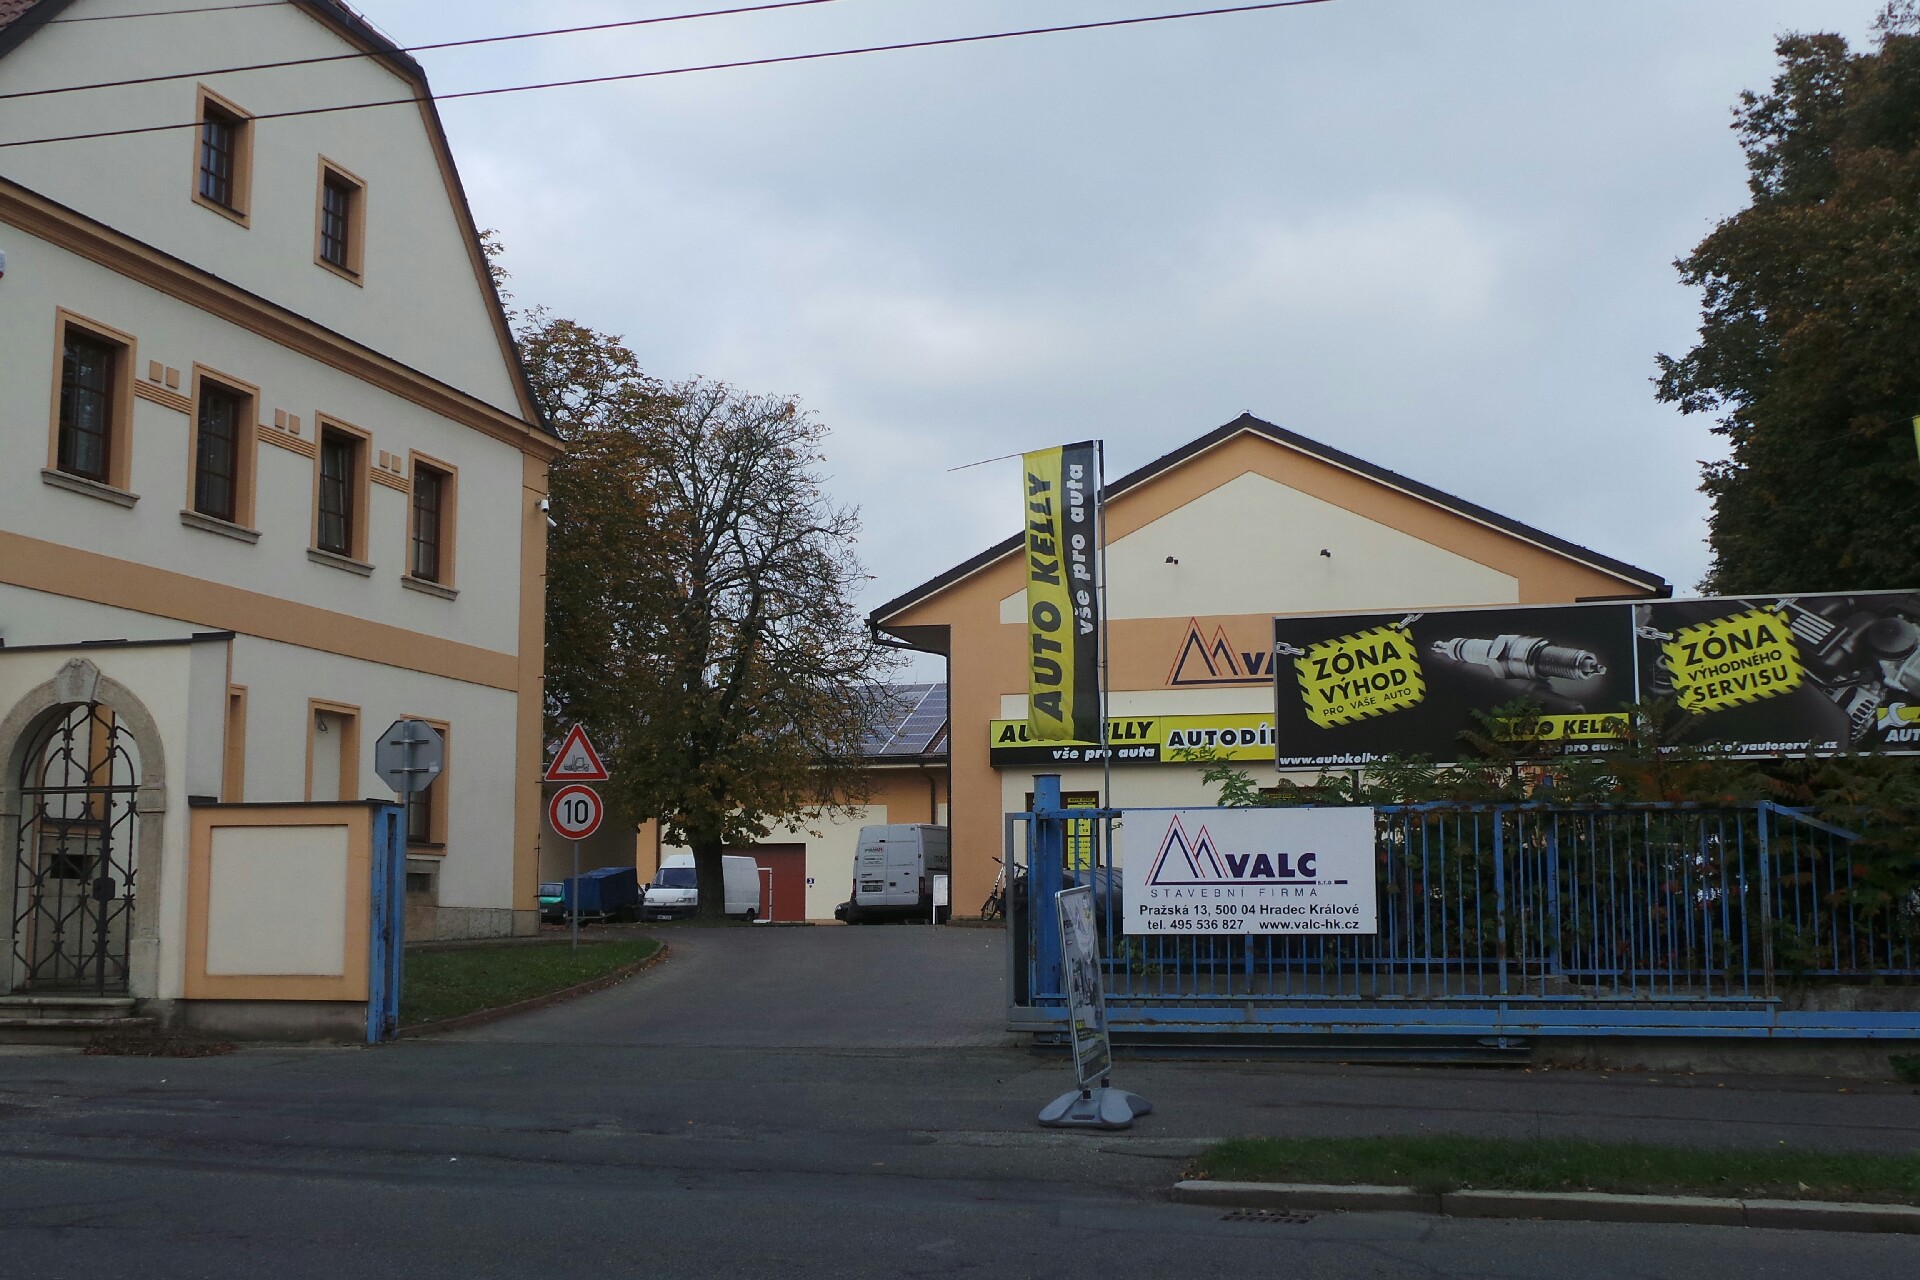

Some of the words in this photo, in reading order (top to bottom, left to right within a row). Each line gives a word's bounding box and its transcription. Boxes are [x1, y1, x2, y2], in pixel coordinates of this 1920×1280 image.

[1066, 464, 1085, 523] auta
[1028, 472, 1061, 586] KELLY
[1071, 533, 1091, 581] pro
[1074, 589, 1096, 636] vše
[1032, 600, 1063, 723] AUTO
[1312, 640, 1402, 682] ZÓNA
[1681, 624, 1778, 667] ZÓNA
[1687, 649, 1783, 683] VÝHODNÉHO
[1693, 664, 1789, 703] SERVISU
[1319, 668, 1408, 704] VÝHOD
[1323, 703, 1346, 718] PRO
[1350, 694, 1376, 710] VAŠE
[1383, 687, 1412, 702] AUTO
[1052, 747, 1079, 760] vše
[1118, 746, 1155, 758] auta
[1564, 743, 1588, 755] pro
[563, 797, 589, 825] 10
[1224, 852, 1317, 878] VALC
[1139, 903, 1189, 916] Pražská
[1193, 904, 1211, 917] 13,
[1214, 904, 1238, 915] 500
[1241, 904, 1256, 915] 04
[1259, 903, 1306, 915] Hradec
[1309, 902, 1360, 915] Králové
[1150, 886, 1245, 898] STAVEBNÍ
[1259, 887, 1318, 898] FIRMA
[1147, 919, 1166, 930] tel.
[1170, 920, 1193, 930] 495
[1196, 920, 1219, 930] 536
[1221, 919, 1244, 930] 827
[1258, 919, 1360, 930] www.valc-hk.cz
